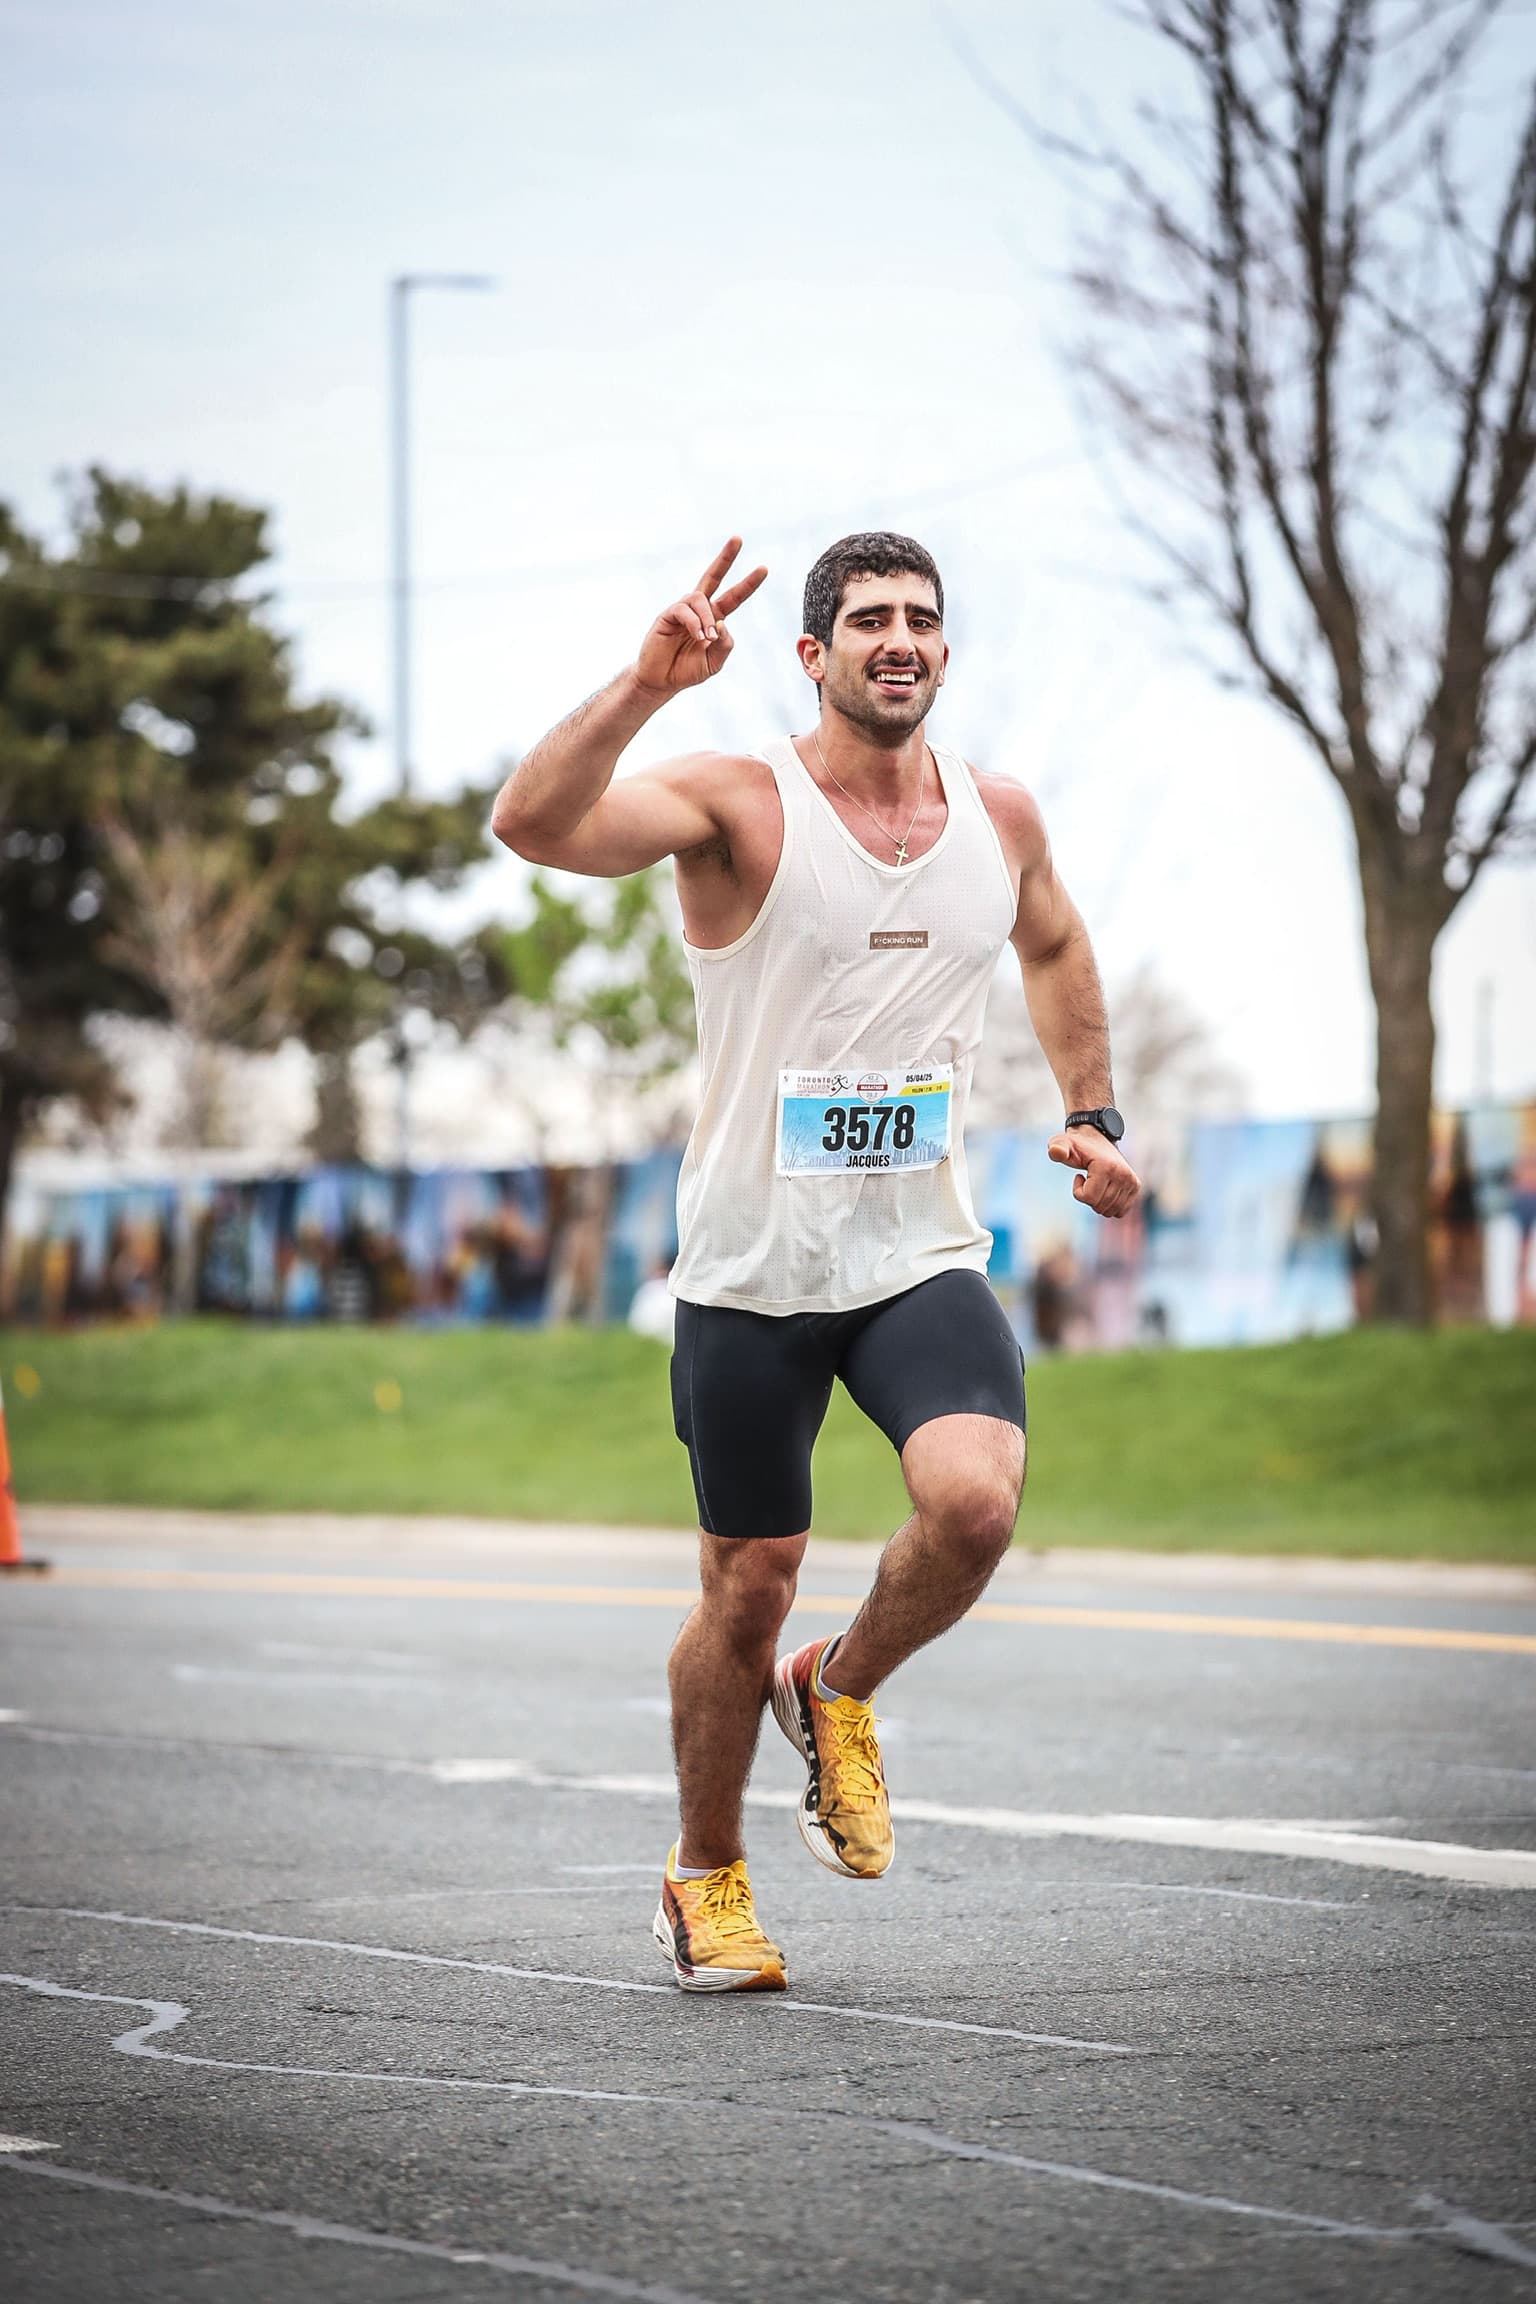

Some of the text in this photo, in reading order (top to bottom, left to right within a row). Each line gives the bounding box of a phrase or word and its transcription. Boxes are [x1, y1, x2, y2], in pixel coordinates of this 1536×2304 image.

[907, 936, 924, 944] RUN
[905, 1073, 933, 1083] 05/04/25
[822, 1104, 915, 1152] 3578
[846, 1154, 890, 1168] JACQUES
